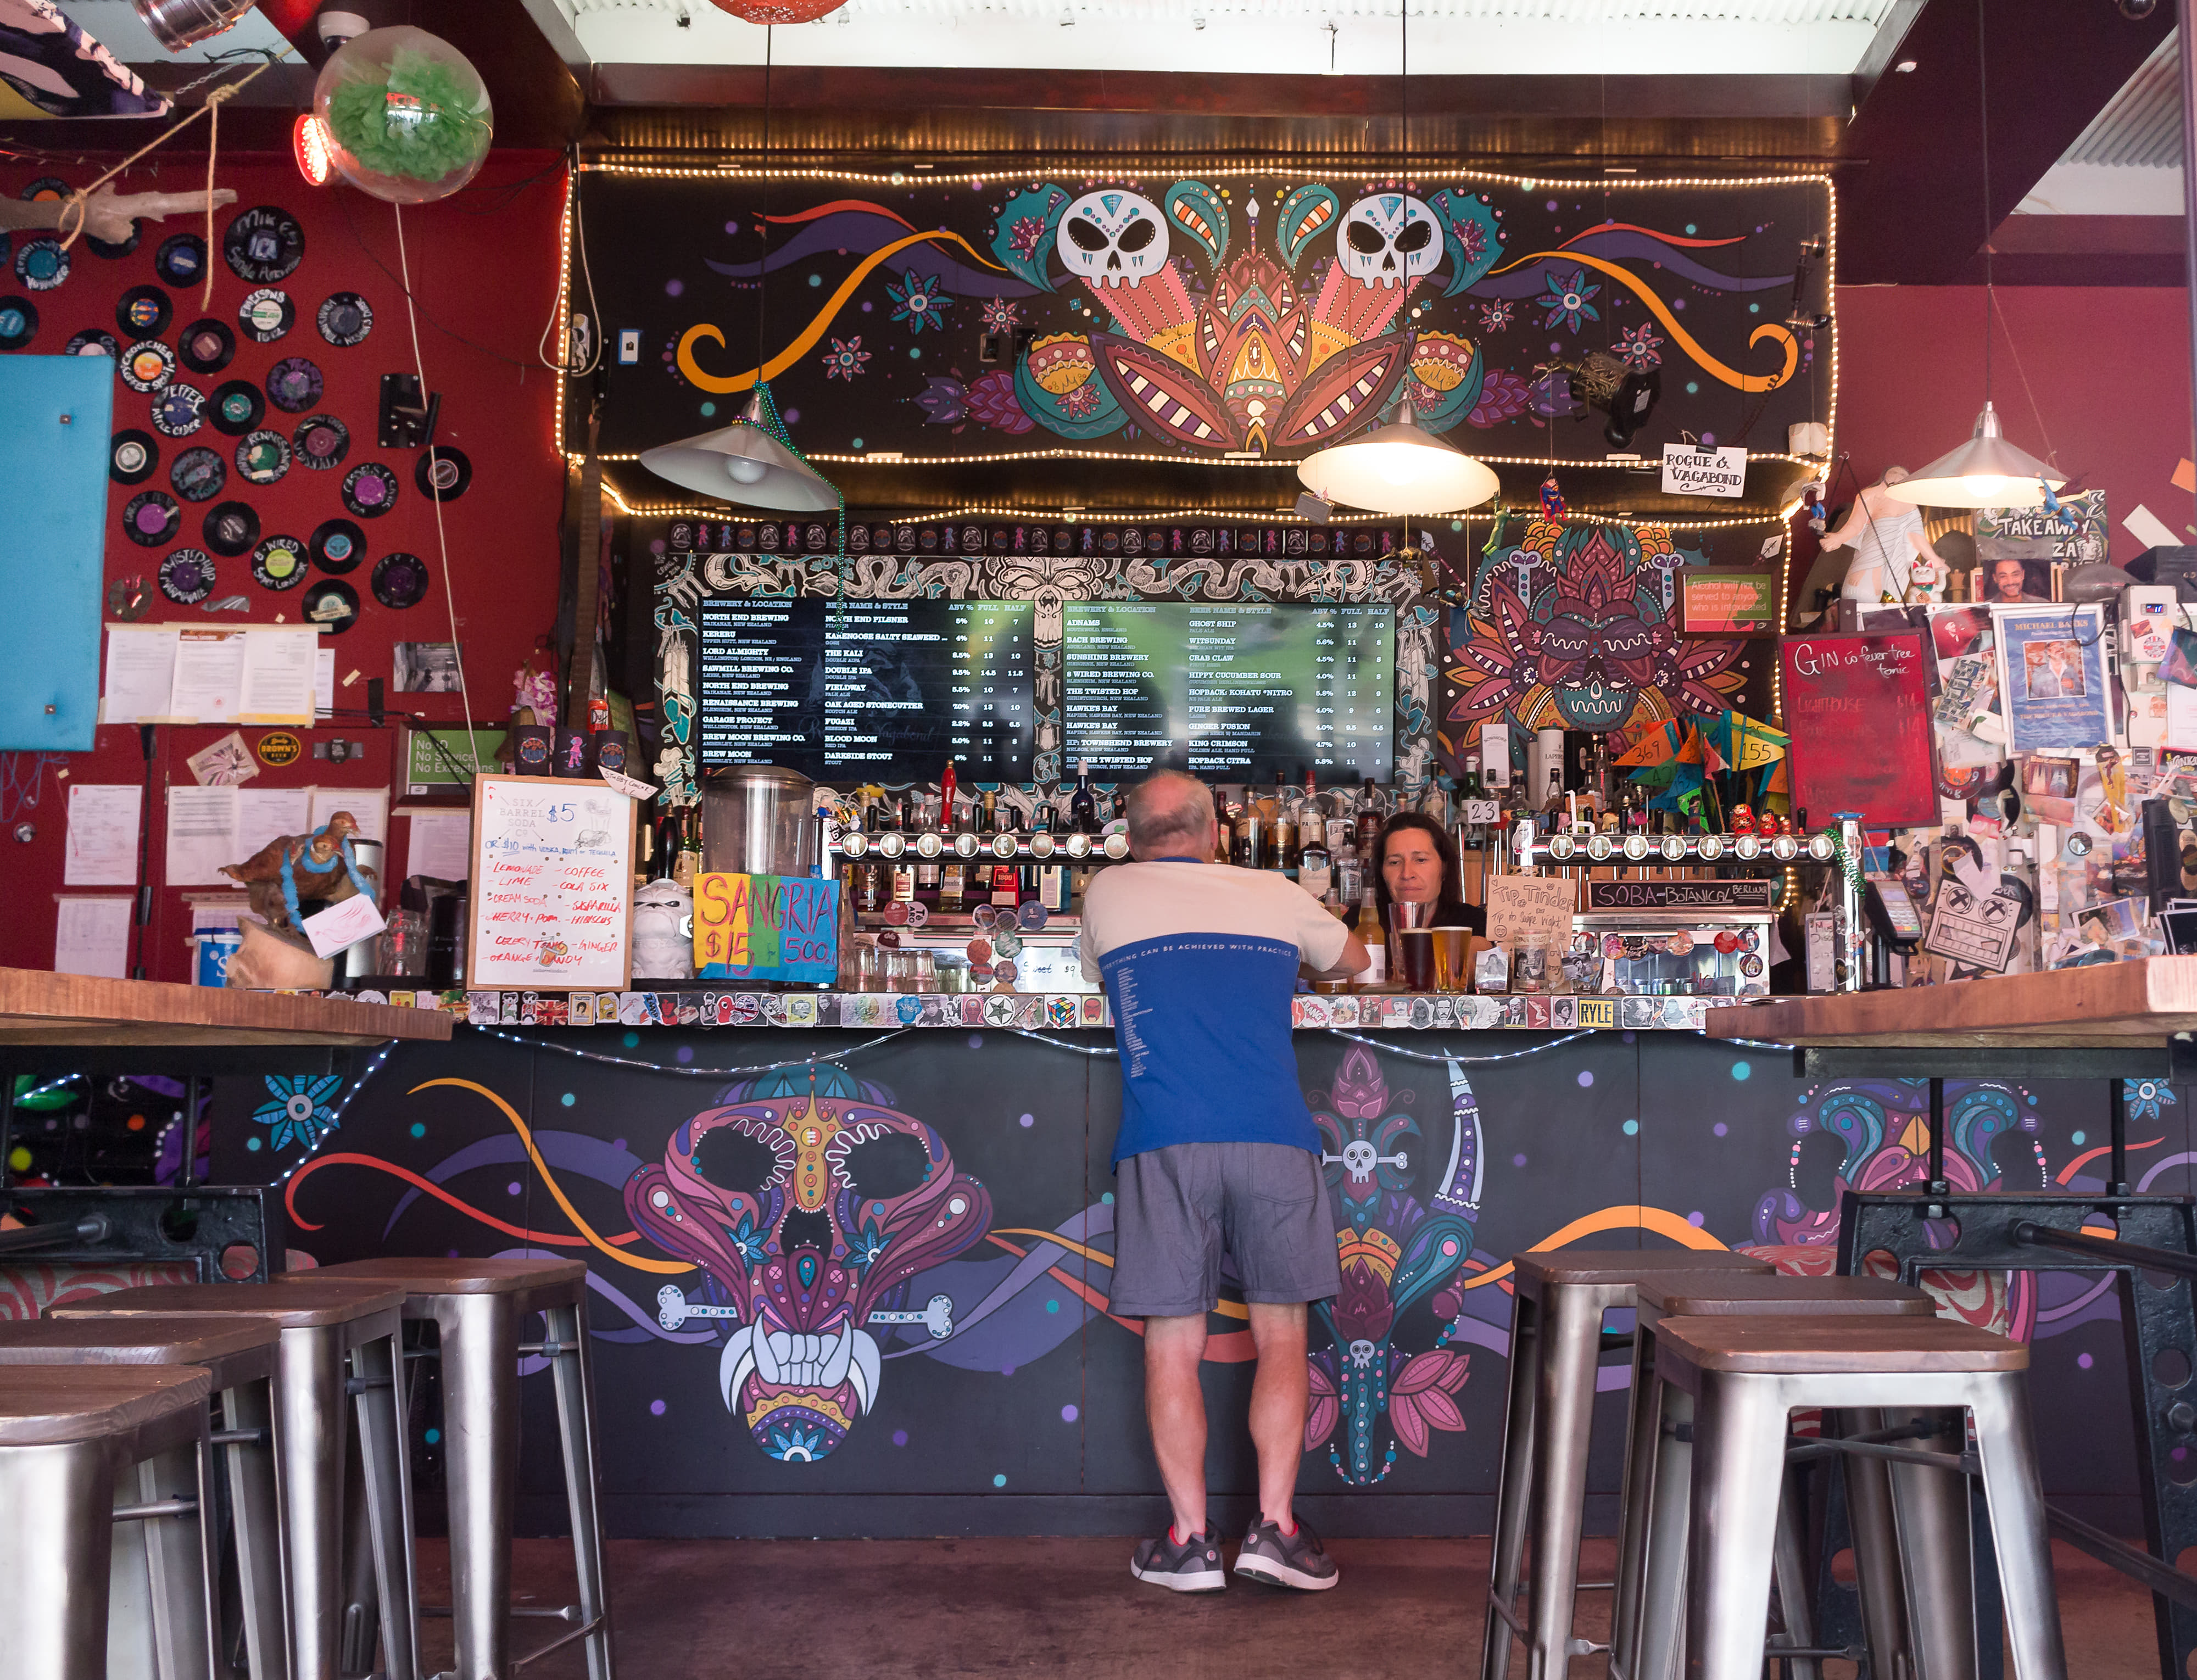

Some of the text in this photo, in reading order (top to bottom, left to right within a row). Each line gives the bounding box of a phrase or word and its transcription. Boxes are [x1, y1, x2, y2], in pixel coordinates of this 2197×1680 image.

[1666, 454, 1731, 469] ROGUE &
[1670, 468, 1742, 486] VAGABOND
[1998, 517, 2091, 535] TAKEAWY
[1692, 581, 1721, 590] Alcohol
[1722, 581, 1738, 589] will
[1755, 581, 1766, 589] be
[1733, 593, 1763, 602] anyone
[1692, 603, 1709, 611] who
[1721, 602, 1766, 611] intoxicated
[2014, 622, 2057, 630] MICHAEL
[1859, 646, 1888, 666] fever
[1888, 644, 1915, 659] tree
[1876, 663, 1910, 679] tonic
[417, 739, 449, 750] No D
[416, 751, 432, 761] No
[1632, 740, 1660, 764] 369
[1741, 743, 1772, 761] 155
[415, 762, 431, 773] No
[512, 799, 534, 807] SIX
[500, 808, 545, 818] BARREL
[547, 803, 577, 823] $5
[1471, 802, 1495, 820] 23
[509, 818, 536, 827] SODA
[485, 840, 500, 849] OR
[501, 838, 519, 851] $10
[493, 862, 544, 875] LEMONADE
[564, 867, 605, 878] COFFEE
[499, 877, 534, 886] LIME
[560, 881, 610, 892] COLA SIX
[494, 894, 547, 907] CREAM SODA
[1493, 885, 1575, 912] Tip Tinder
[700, 874, 836, 939] SANGRIA
[571, 915, 614, 925] HIBISCUS
[1492, 909, 1504, 923] Tip
[1509, 911, 1516, 922] to
[495, 936, 531, 946] CELERY
[578, 939, 618, 952] GINGER
[490, 953, 533, 962] ORANGE
[705, 929, 755, 976] $15
[1101, 953, 1137, 972] EVERYTHING
[1141, 948, 1159, 957] CAN
[1257, 946, 1292, 957] PRACTICE
[1581, 1003, 1613, 1023] RYLE
